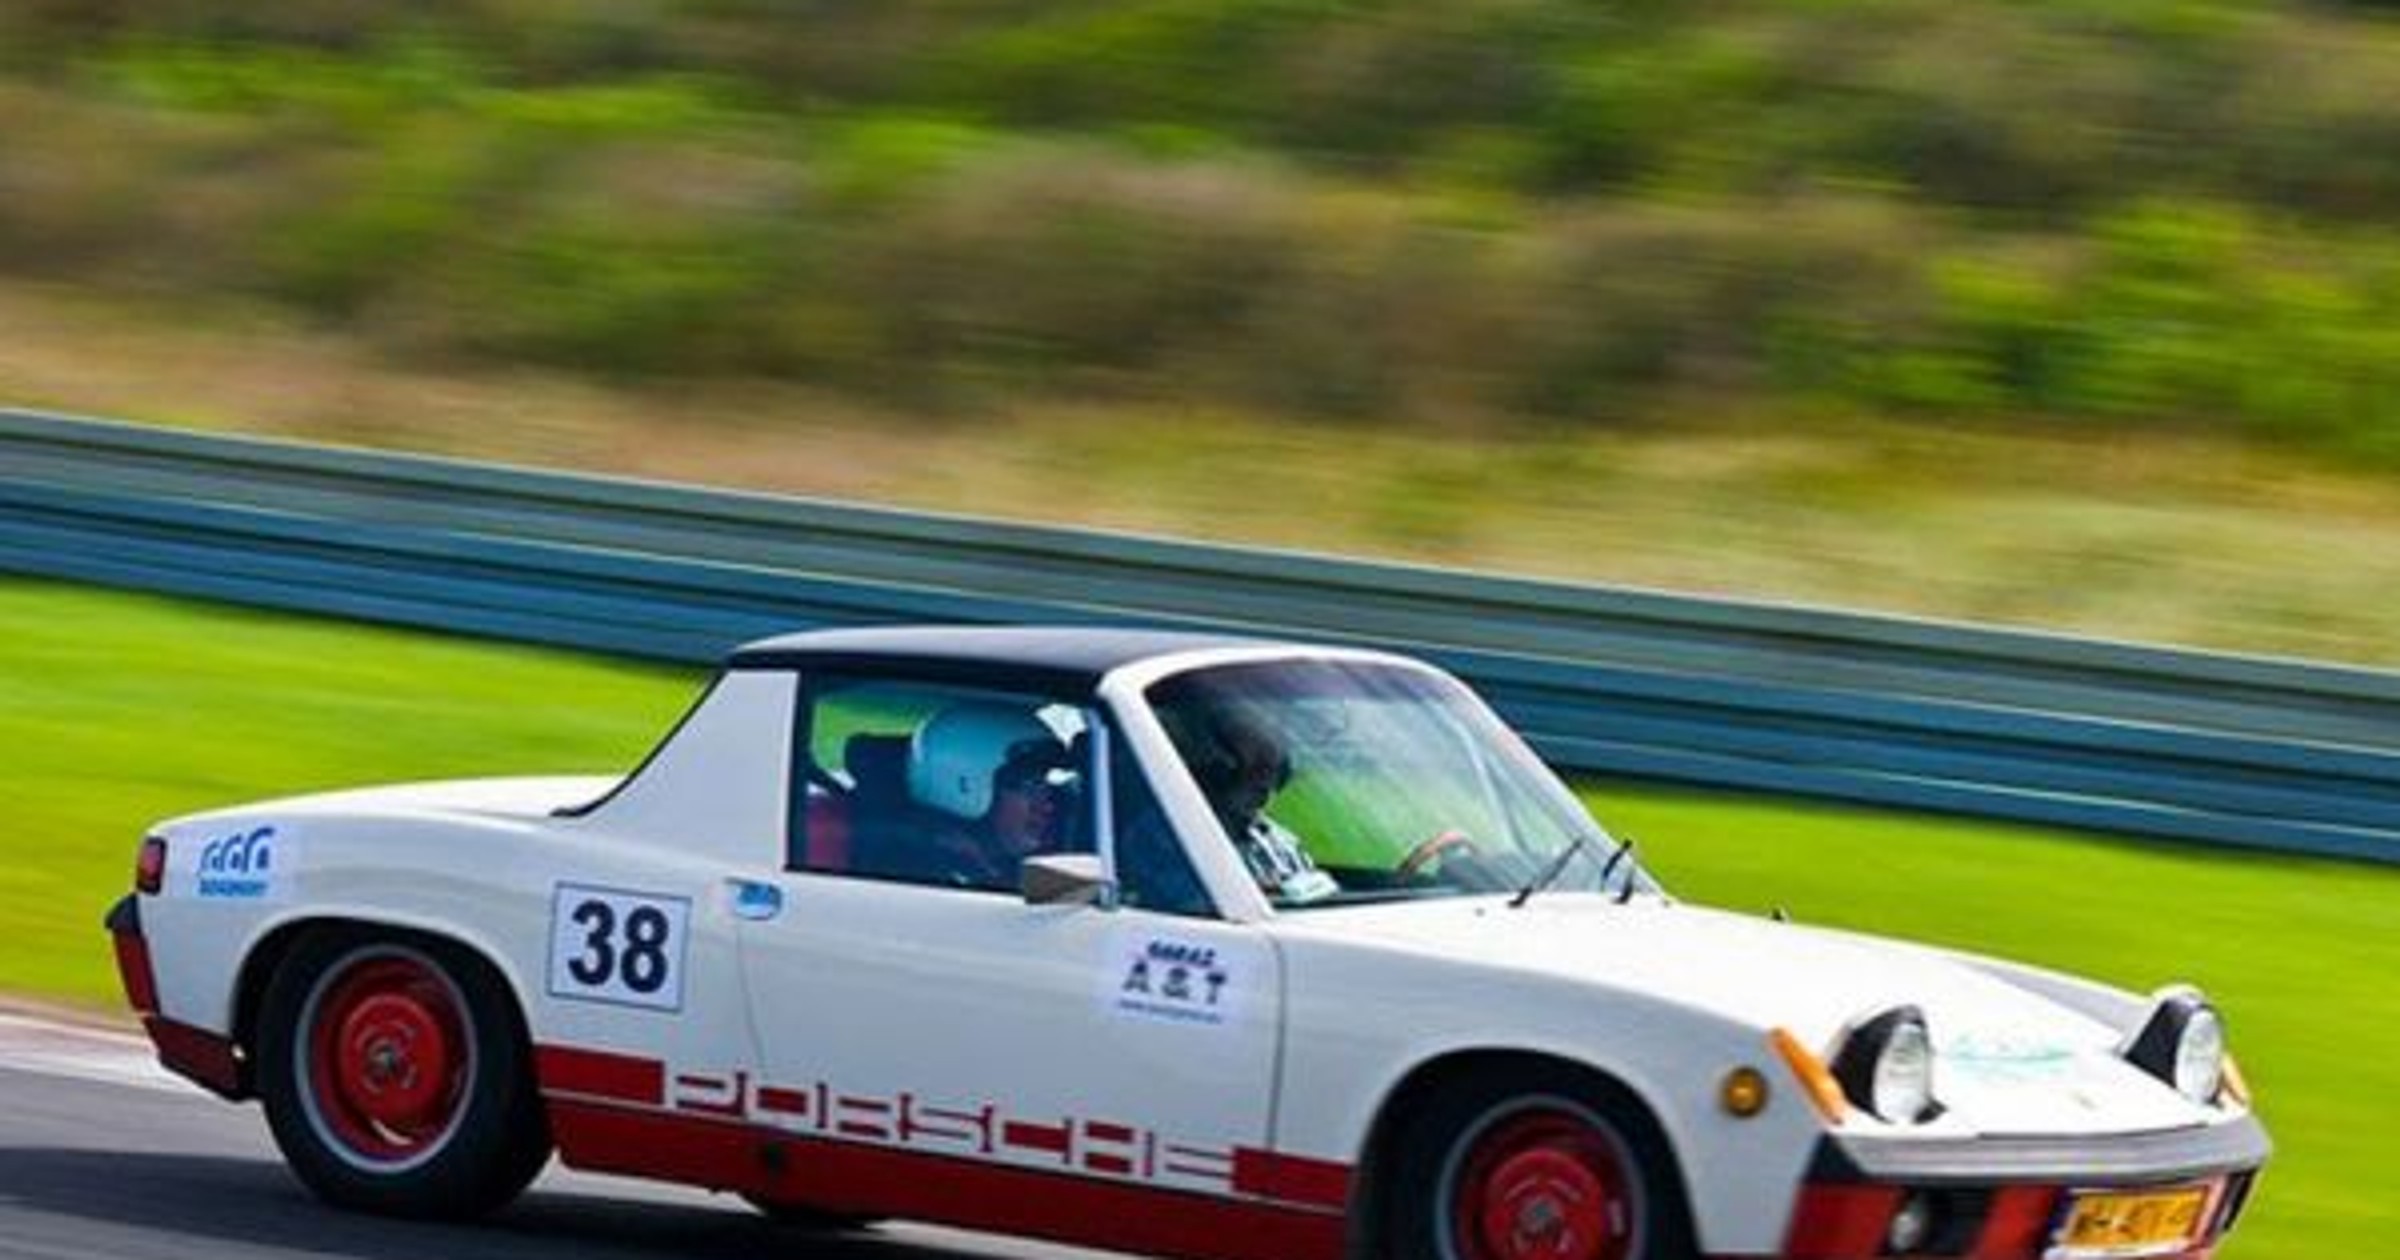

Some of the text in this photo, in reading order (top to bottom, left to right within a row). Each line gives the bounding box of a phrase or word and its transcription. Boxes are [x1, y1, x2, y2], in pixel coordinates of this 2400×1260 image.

[568, 900, 669, 993] 38
[1122, 959, 1150, 993] A
[662, 1064, 1235, 1196] PORSCHE
